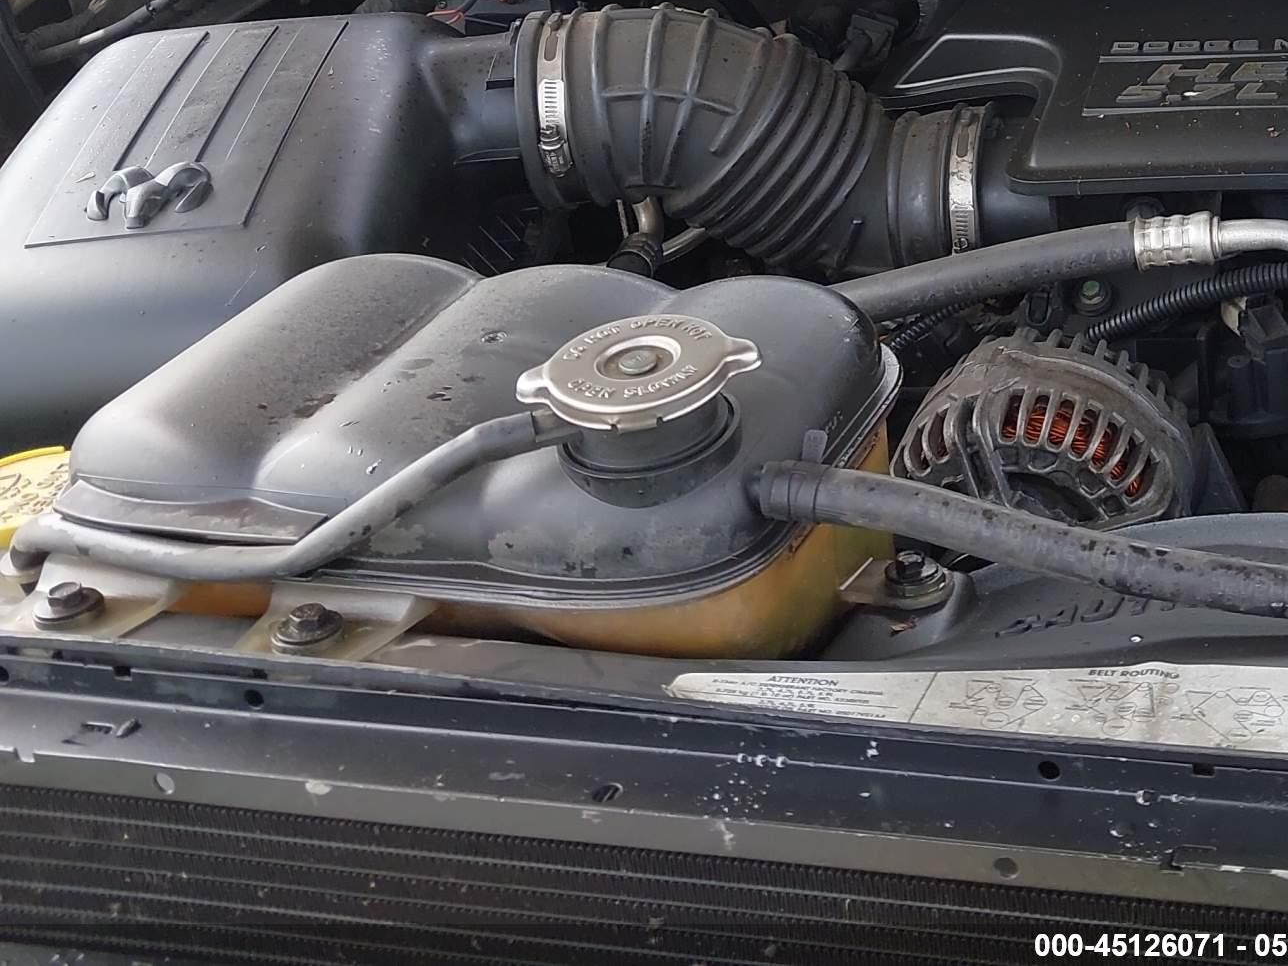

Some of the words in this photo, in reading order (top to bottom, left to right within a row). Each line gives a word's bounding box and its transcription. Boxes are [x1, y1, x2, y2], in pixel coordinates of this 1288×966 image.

[1110, 39, 1259, 54] DODGE
[630, 317, 686, 330] OPEN
[567, 377, 616, 400] OPEN
[767, 675, 839, 686] ATTENTION
[1088, 669, 1117, 677] BELT
[1119, 668, 1180, 680] ROUTING
